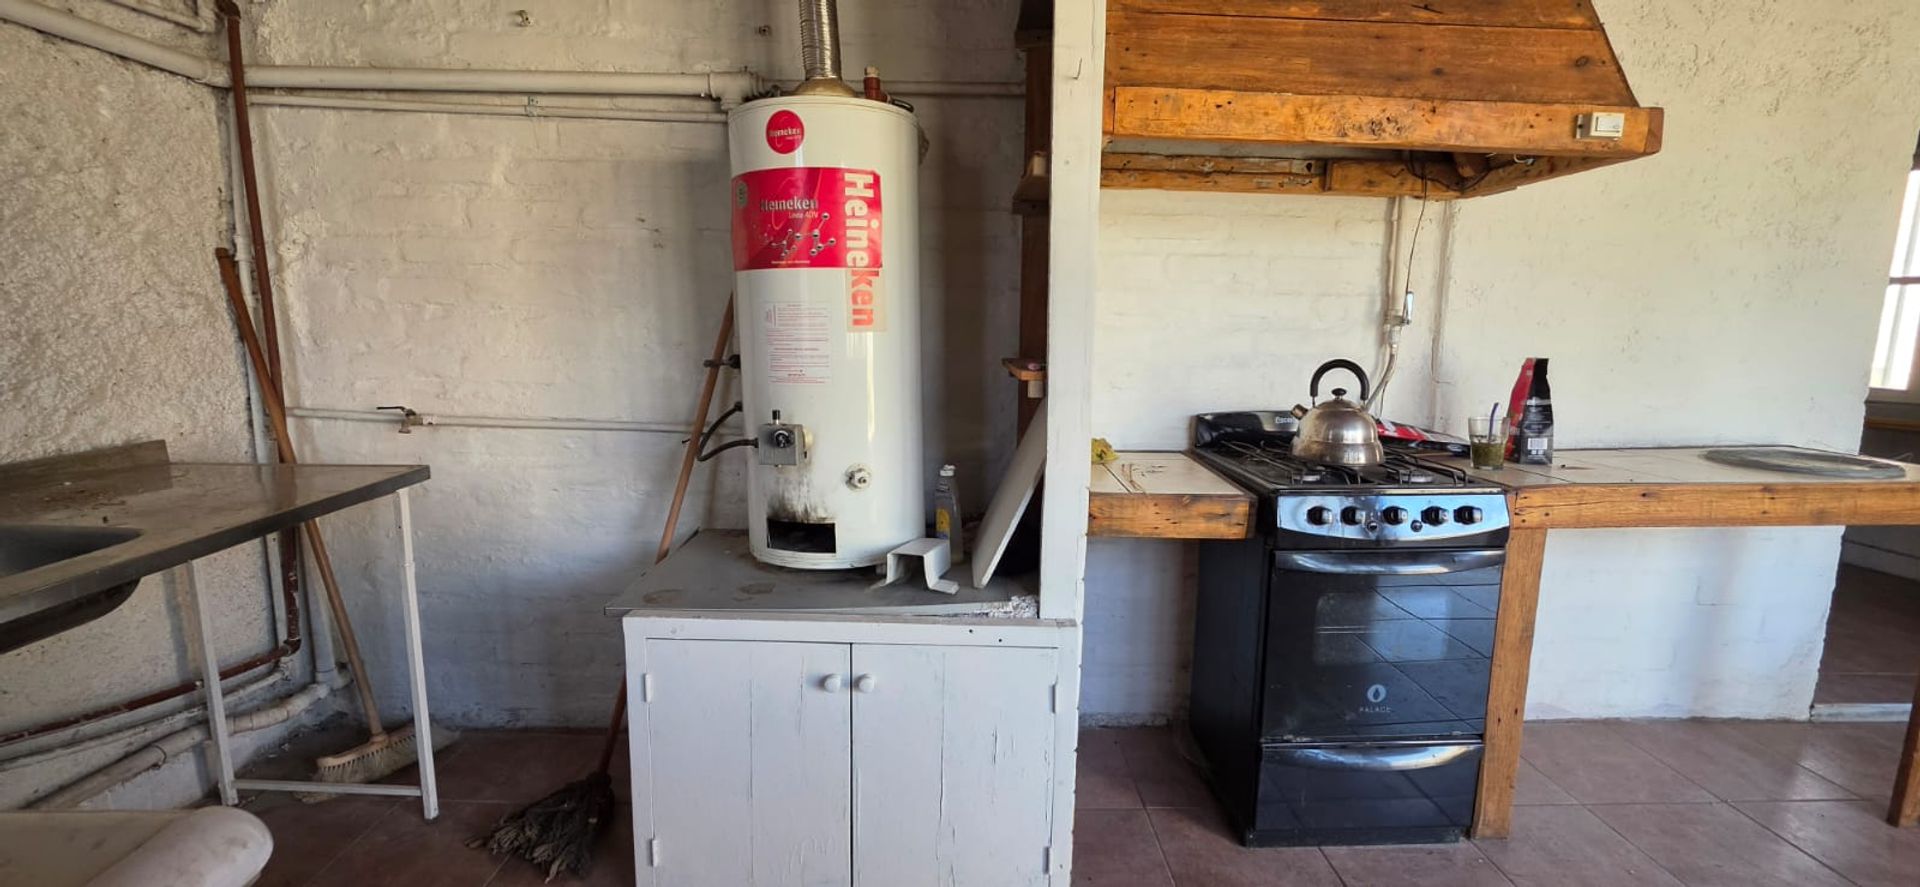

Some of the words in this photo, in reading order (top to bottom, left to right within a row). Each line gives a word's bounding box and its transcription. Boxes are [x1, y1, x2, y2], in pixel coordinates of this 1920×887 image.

[760, 196, 819, 212] Heineken
[844, 172, 880, 326] Heineken
[1358, 705, 1392, 713] PALACE
